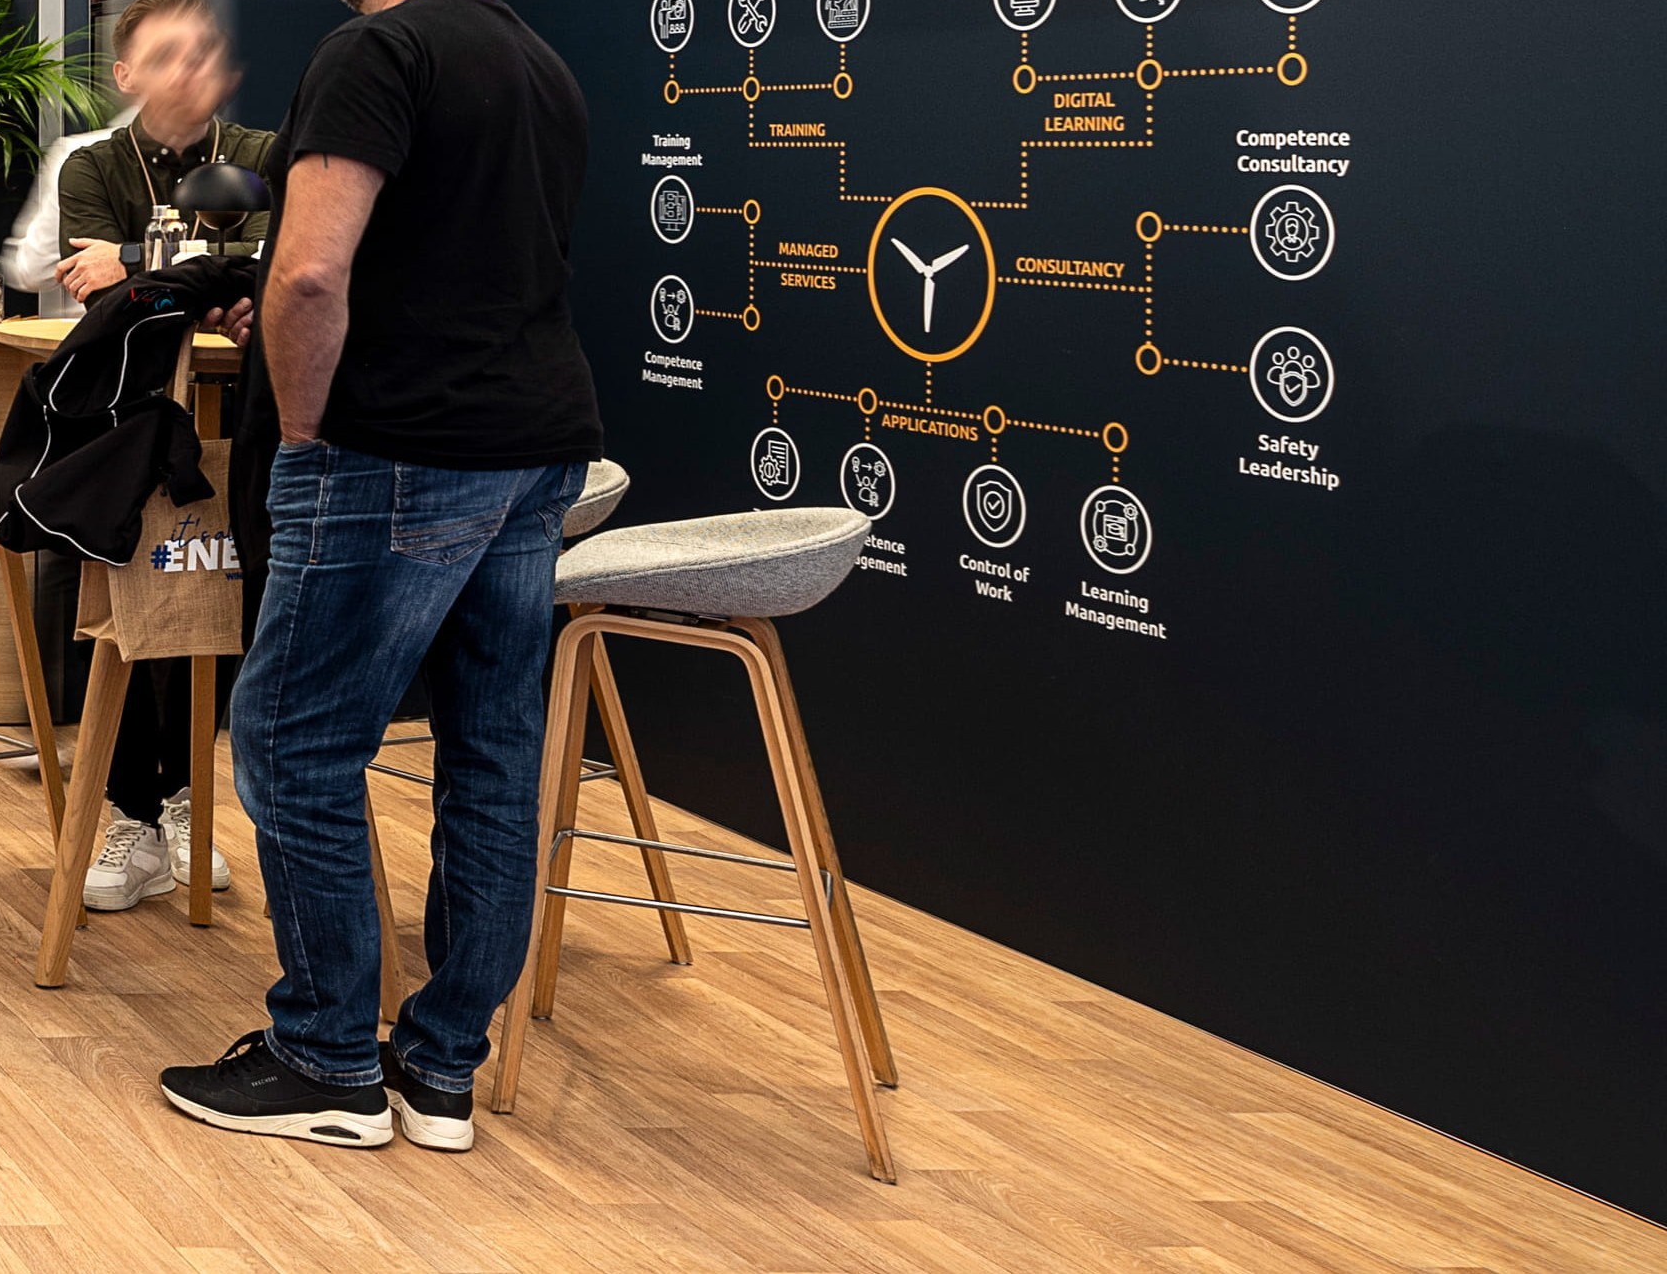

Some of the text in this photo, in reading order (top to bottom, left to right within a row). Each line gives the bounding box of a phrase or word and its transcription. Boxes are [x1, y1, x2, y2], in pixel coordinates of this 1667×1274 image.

[1054, 92, 1115, 108] DIGITAL
[769, 123, 826, 137] TRAINING
[1045, 116, 1125, 132] LEARNING
[652, 134, 691, 149] Training
[1236, 130, 1351, 149] Competence
[642, 153, 703, 168] Management
[1237, 154, 1350, 176] Consultancy
[779, 242, 839, 258] MANAGED
[1015, 257, 1125, 278] CONSULTANCY
[780, 273, 836, 290] SERVICES
[644, 351, 703, 371] Competence
[642, 369, 703, 390] Management
[881, 414, 978, 441] APPLICATIONS
[1258, 434, 1319, 461] Safety
[1239, 457, 1340, 491] Leadership
[150, 538, 241, 572] #ENE
[864, 534, 905, 555] etence
[854, 557, 907, 578] agement
[959, 554, 1030, 583] Control of
[975, 580, 1013, 603] Work
[1081, 582, 1149, 614] Learning
[1065, 601, 1167, 640] Management
